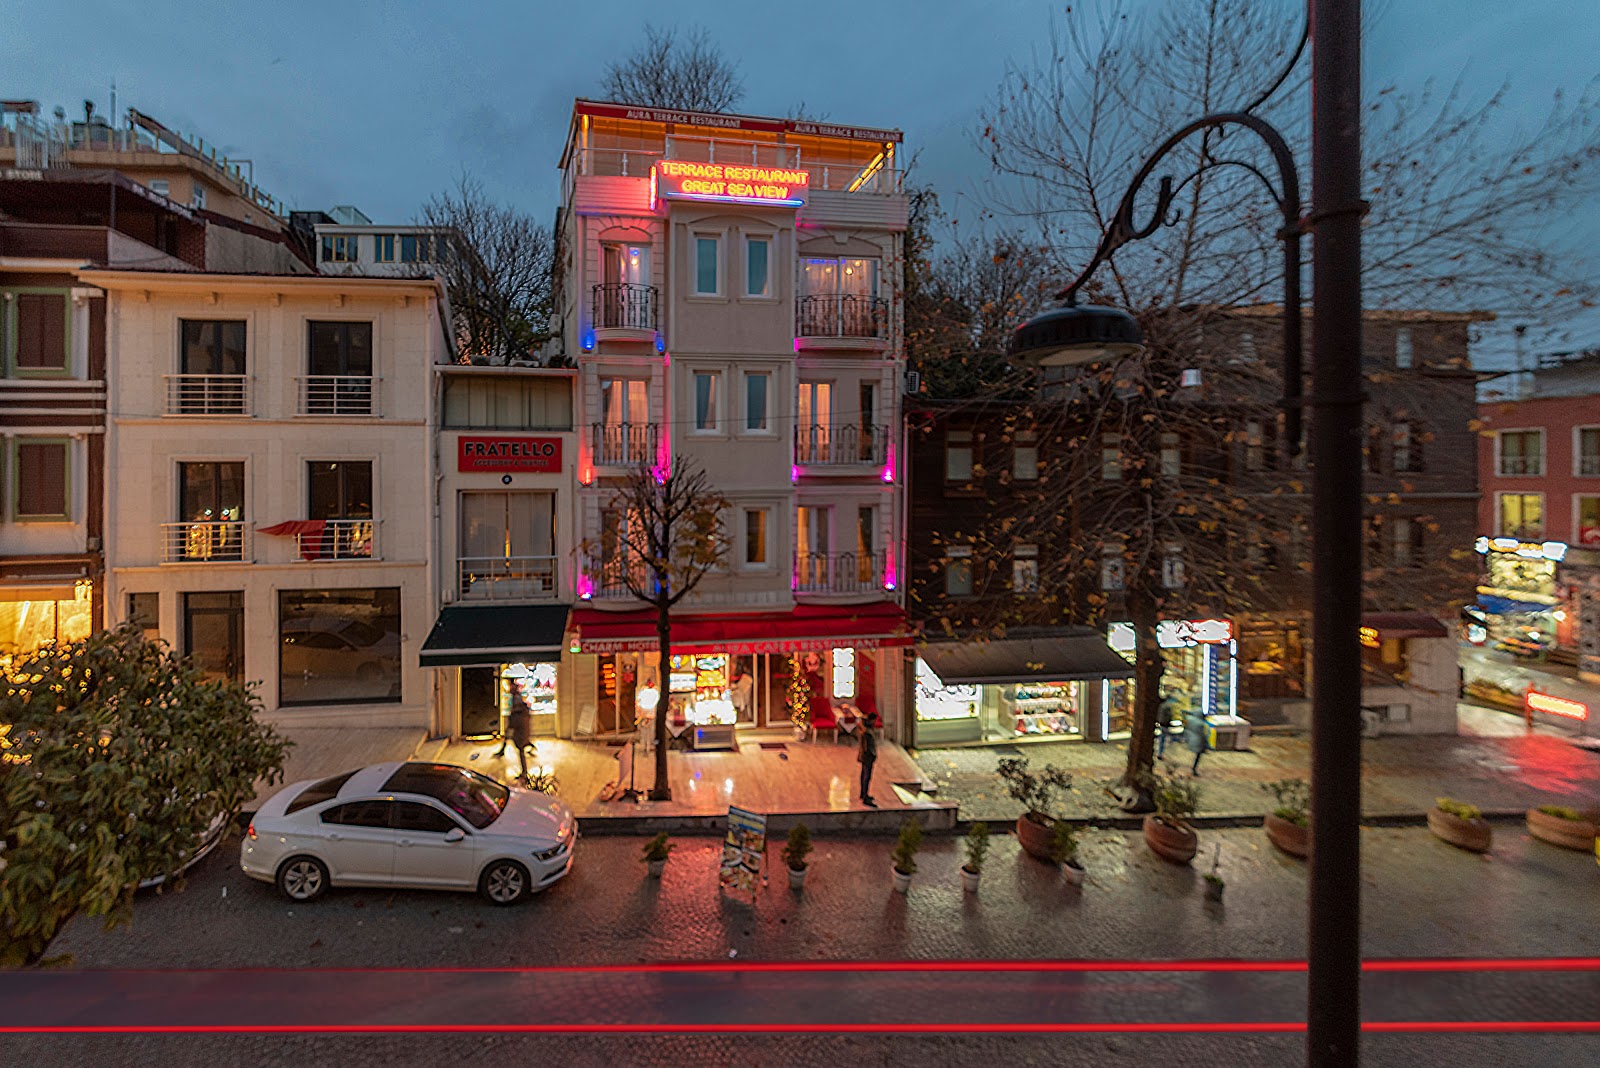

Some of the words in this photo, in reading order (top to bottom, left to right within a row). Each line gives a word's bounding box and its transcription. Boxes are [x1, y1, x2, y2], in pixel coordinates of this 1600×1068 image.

[626, 110, 651, 120] AURA
[653, 112, 688, 123] TERRACE
[690, 116, 740, 128] RESTAURANT
[819, 126, 851, 137] TERRACE
[853, 129, 900, 140] RESTAURANT
[661, 162, 723, 178] TERRACE
[725, 167, 808, 184] RESTAURANT
[682, 179, 726, 195] GREAT
[727, 183, 754, 196] SEA
[755, 185, 788, 199] VIEW
[464, 442, 555, 456] FRATELLO
[582, 640, 623, 653] CHARM
[752, 640, 784, 653] CAFE
[800, 638, 881, 650] RESTAURANT
